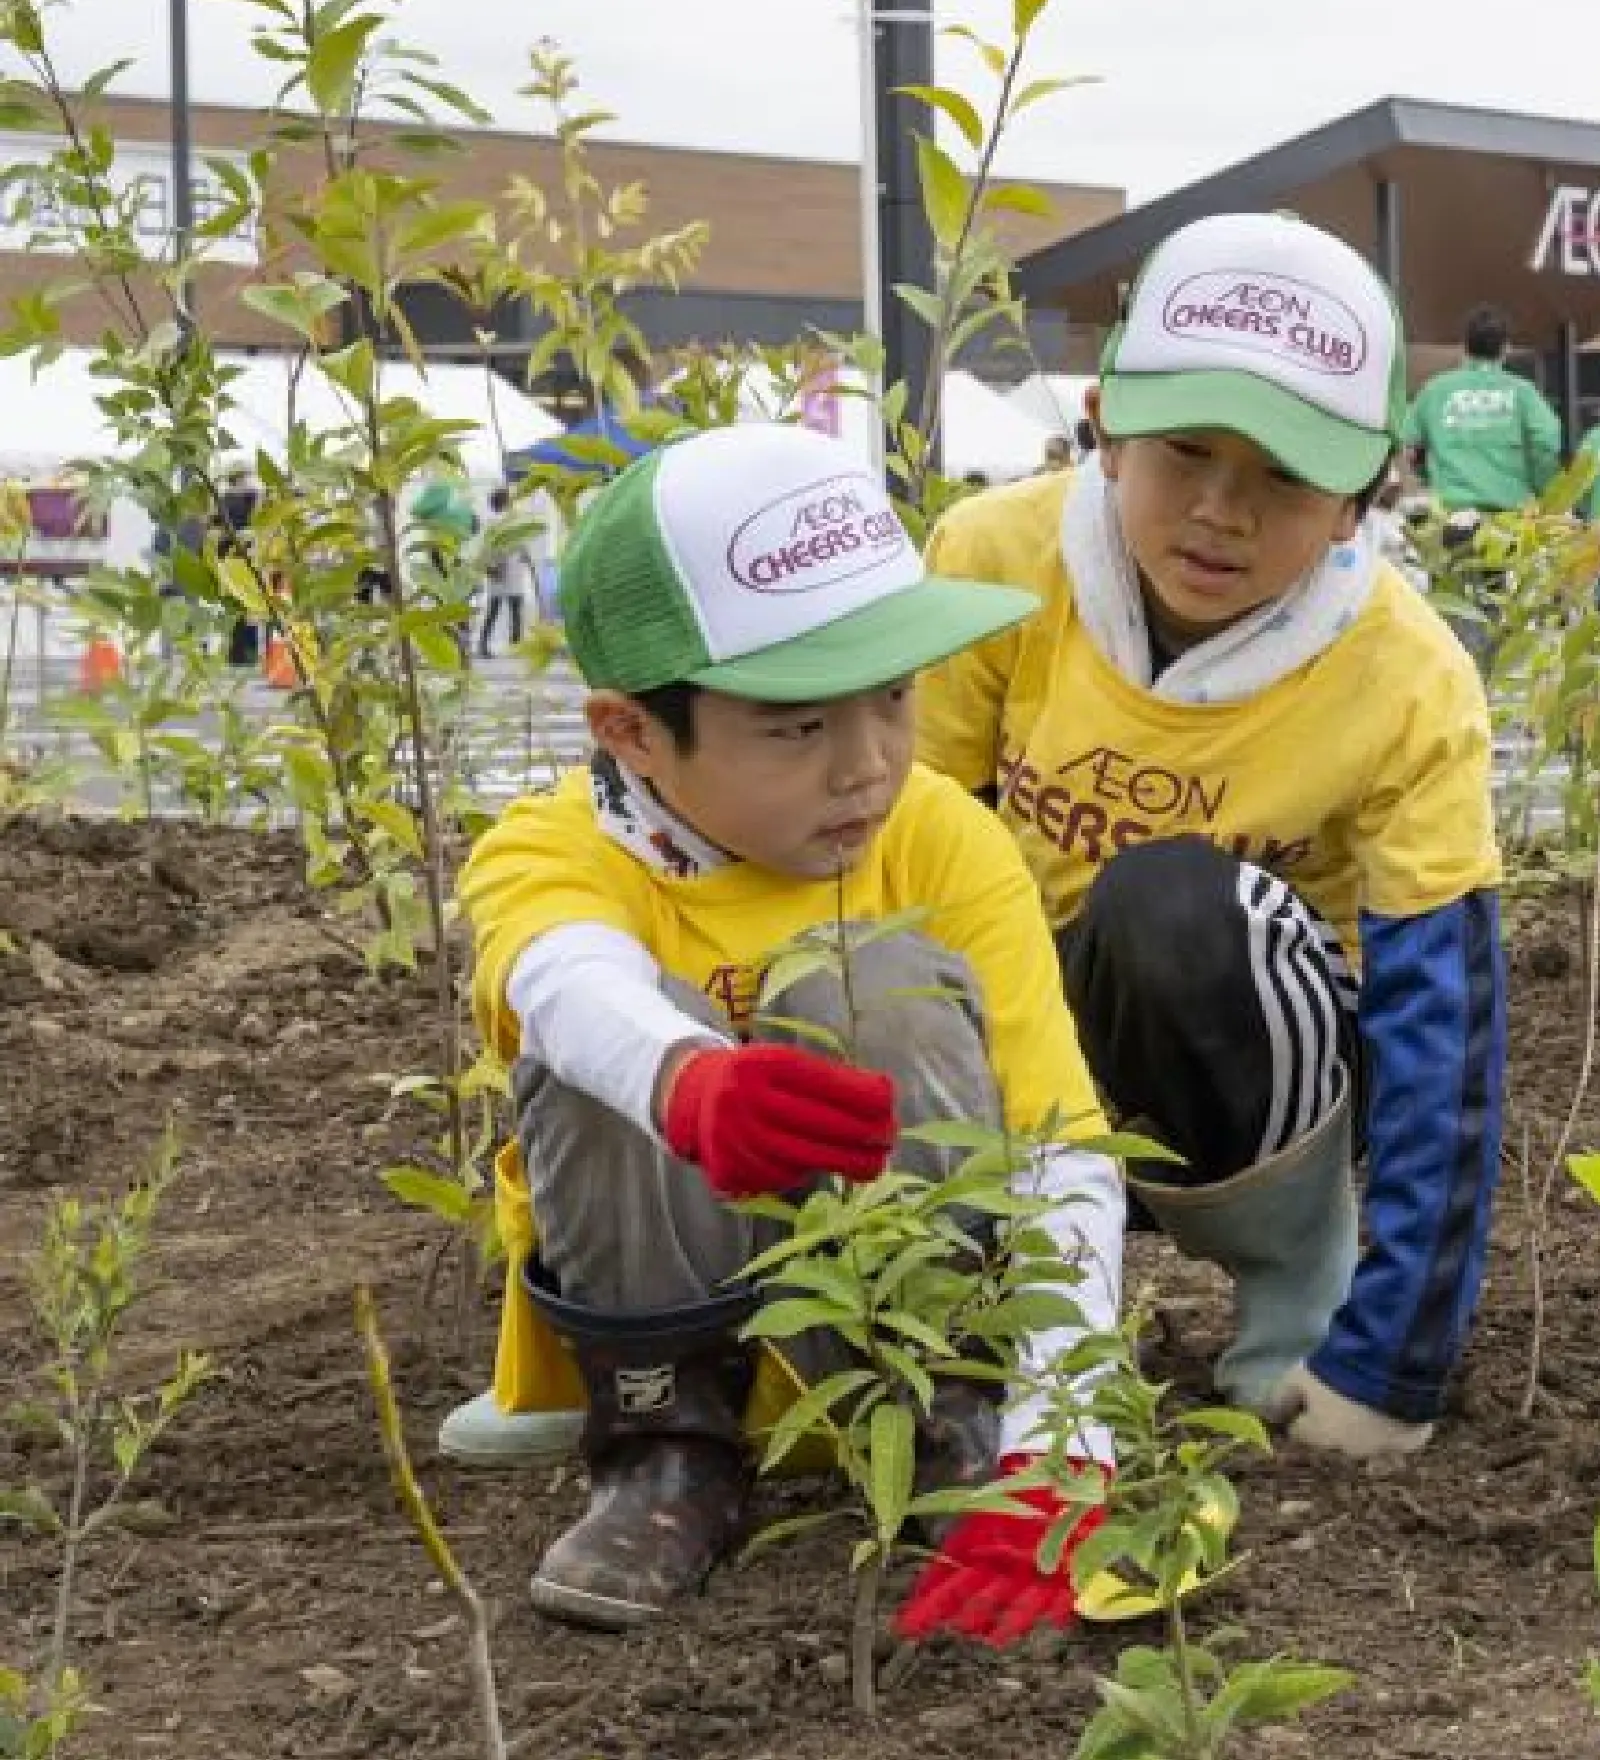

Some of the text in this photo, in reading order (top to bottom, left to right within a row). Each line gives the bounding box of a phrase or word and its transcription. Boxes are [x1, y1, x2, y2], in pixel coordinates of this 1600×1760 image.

[1217, 283, 1311, 321] ÆON
[1173, 304, 1352, 367] CHEERS CLUB
[789, 493, 865, 537] ÆON
[748, 523, 861, 584] CHEERS
[1055, 746, 1228, 823] ÆON
